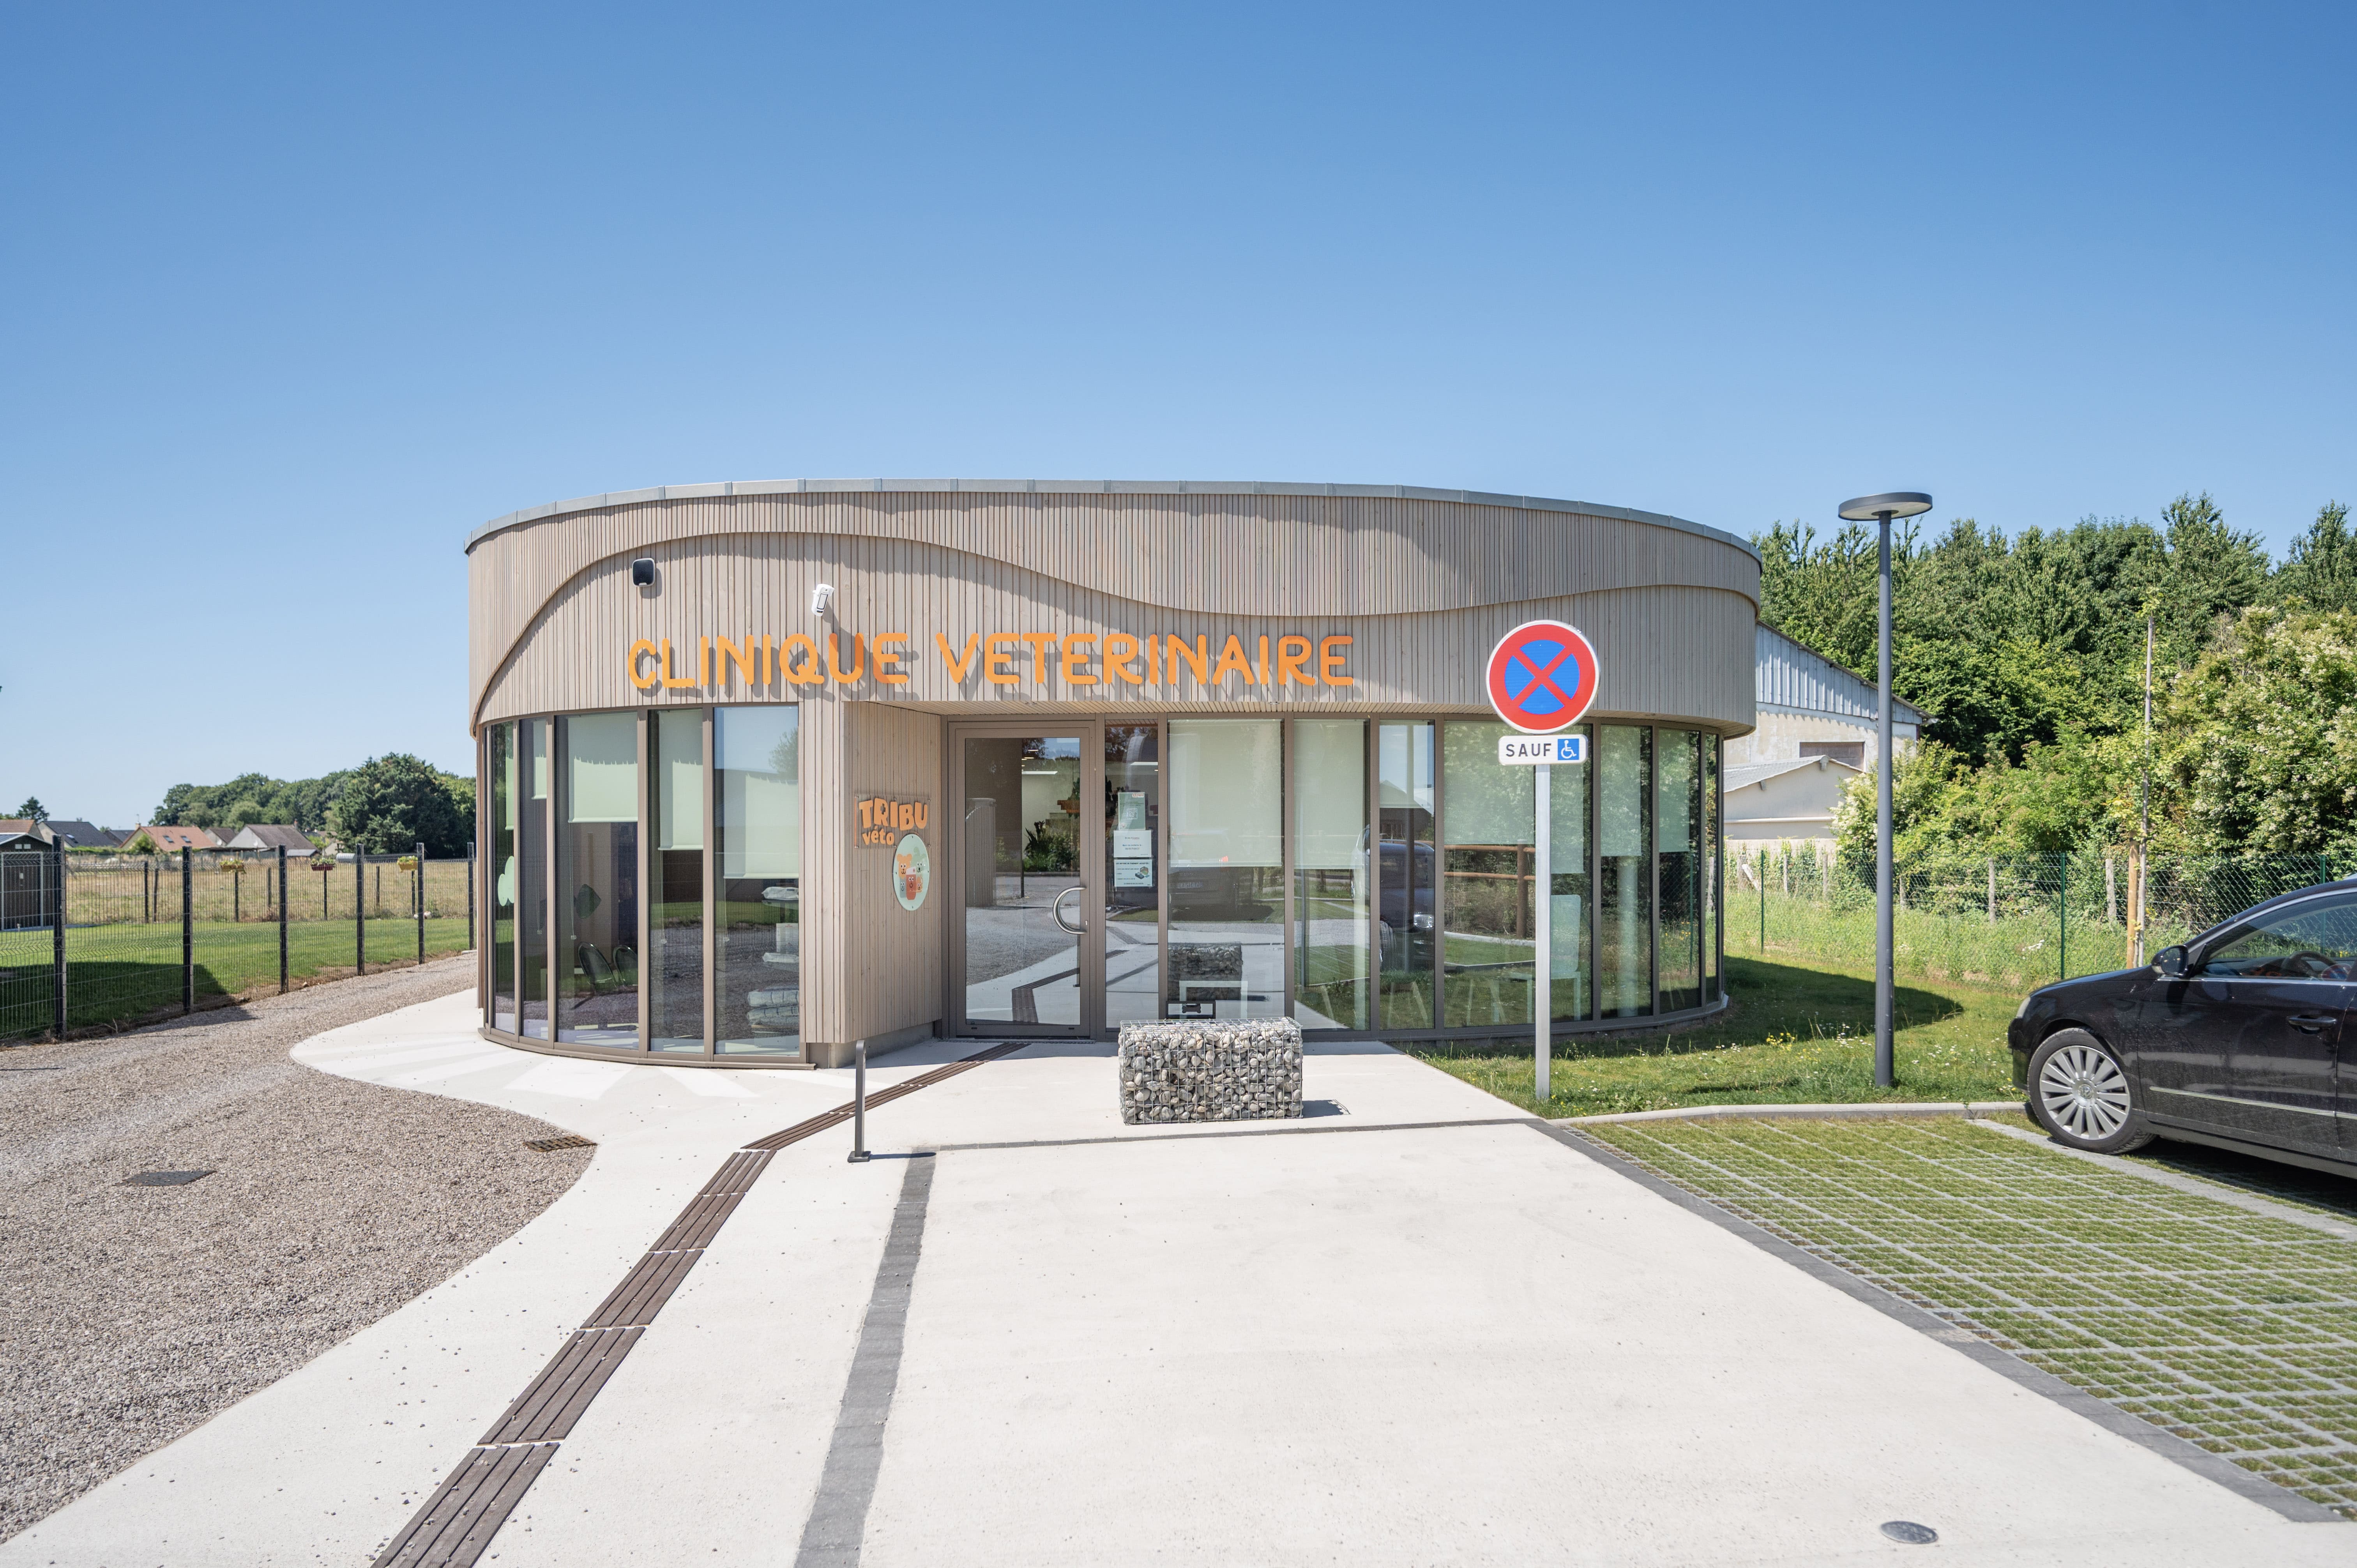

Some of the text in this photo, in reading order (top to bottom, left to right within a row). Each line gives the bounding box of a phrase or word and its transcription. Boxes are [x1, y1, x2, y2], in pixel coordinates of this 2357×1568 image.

[628, 632, 1353, 689] CLINIQUE VETERINAIRE
[1506, 743, 1551, 757] SAUF
[859, 798, 928, 831] TRIBU
[862, 826, 895, 845] véto
